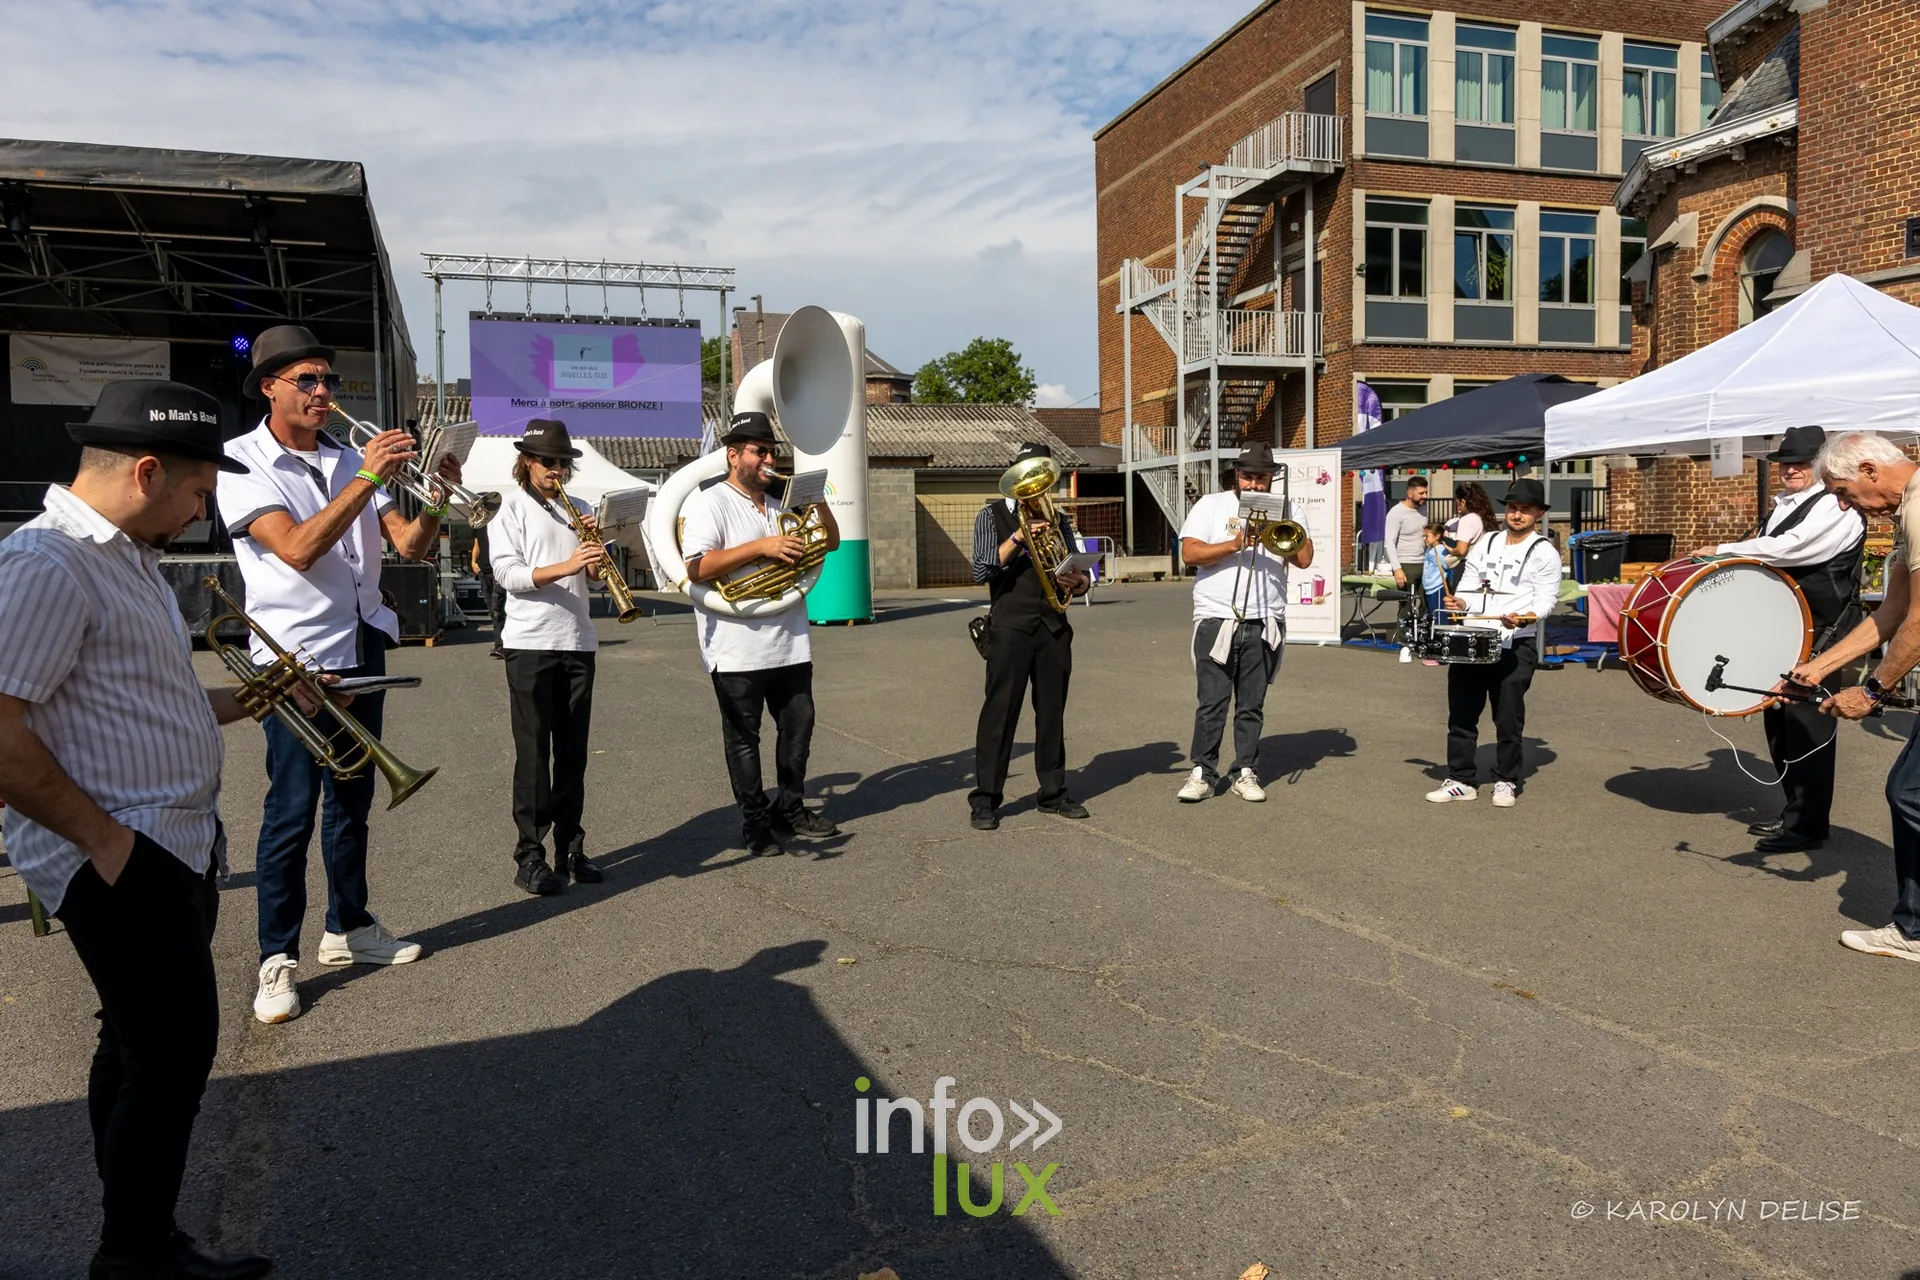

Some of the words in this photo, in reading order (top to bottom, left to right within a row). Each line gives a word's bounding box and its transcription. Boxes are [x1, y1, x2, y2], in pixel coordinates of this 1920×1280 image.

[96, 361, 133, 369] participation
[561, 371, 608, 380] NIVELLES-SUD
[338, 380, 376, 393] ERCI
[511, 398, 538, 407] Merci
[541, 399, 546, 407] à
[550, 400, 575, 408] notre
[578, 401, 617, 409] sponsor
[618, 401, 658, 409] BRONZE
[149, 409, 166, 421] No
[168, 409, 199, 421] Man's
[199, 411, 217, 424] Band
[1289, 465, 1324, 479] ESET
[1307, 496, 1326, 505] jours
[1697, 569, 1735, 589] Gibraltar
